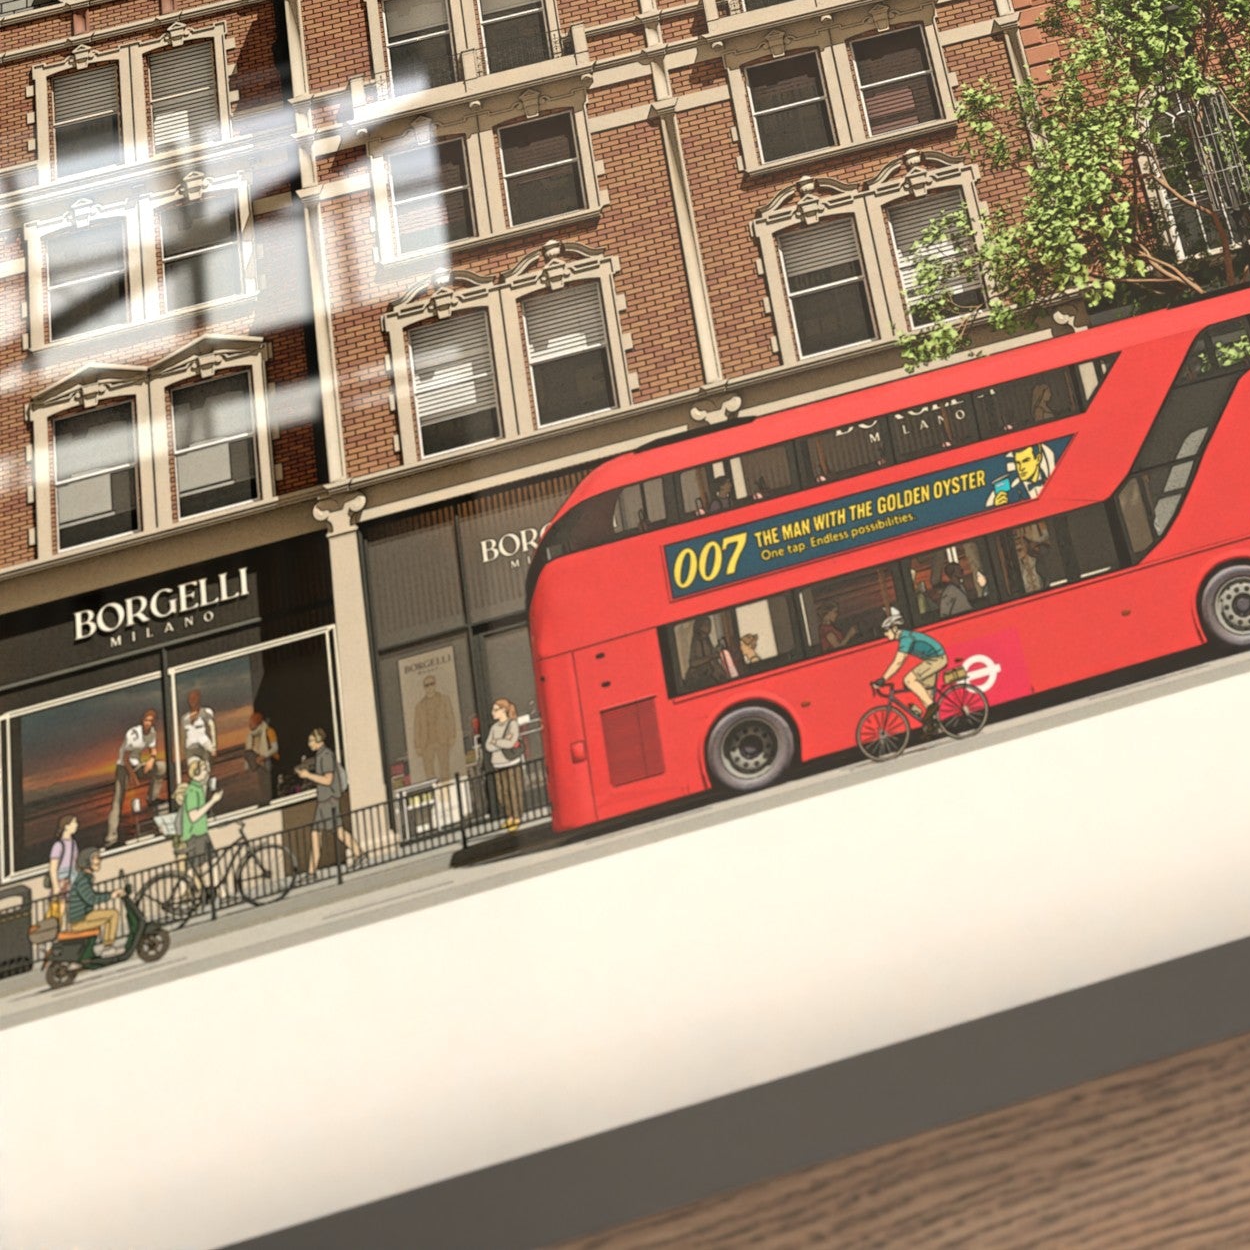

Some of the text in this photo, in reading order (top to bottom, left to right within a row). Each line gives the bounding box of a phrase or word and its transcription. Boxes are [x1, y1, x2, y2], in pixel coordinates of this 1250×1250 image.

[869, 408, 966, 443] MLANO
[673, 469, 986, 589] 007 THE MAN WITH THE GOLDEN OYSTER
[760, 547, 785, 561] One
[810, 529, 849, 548] Endless
[851, 513, 917, 539] possibilities.
[73, 566, 250, 642] BORGELLI
[110, 610, 215, 648] MILANO
